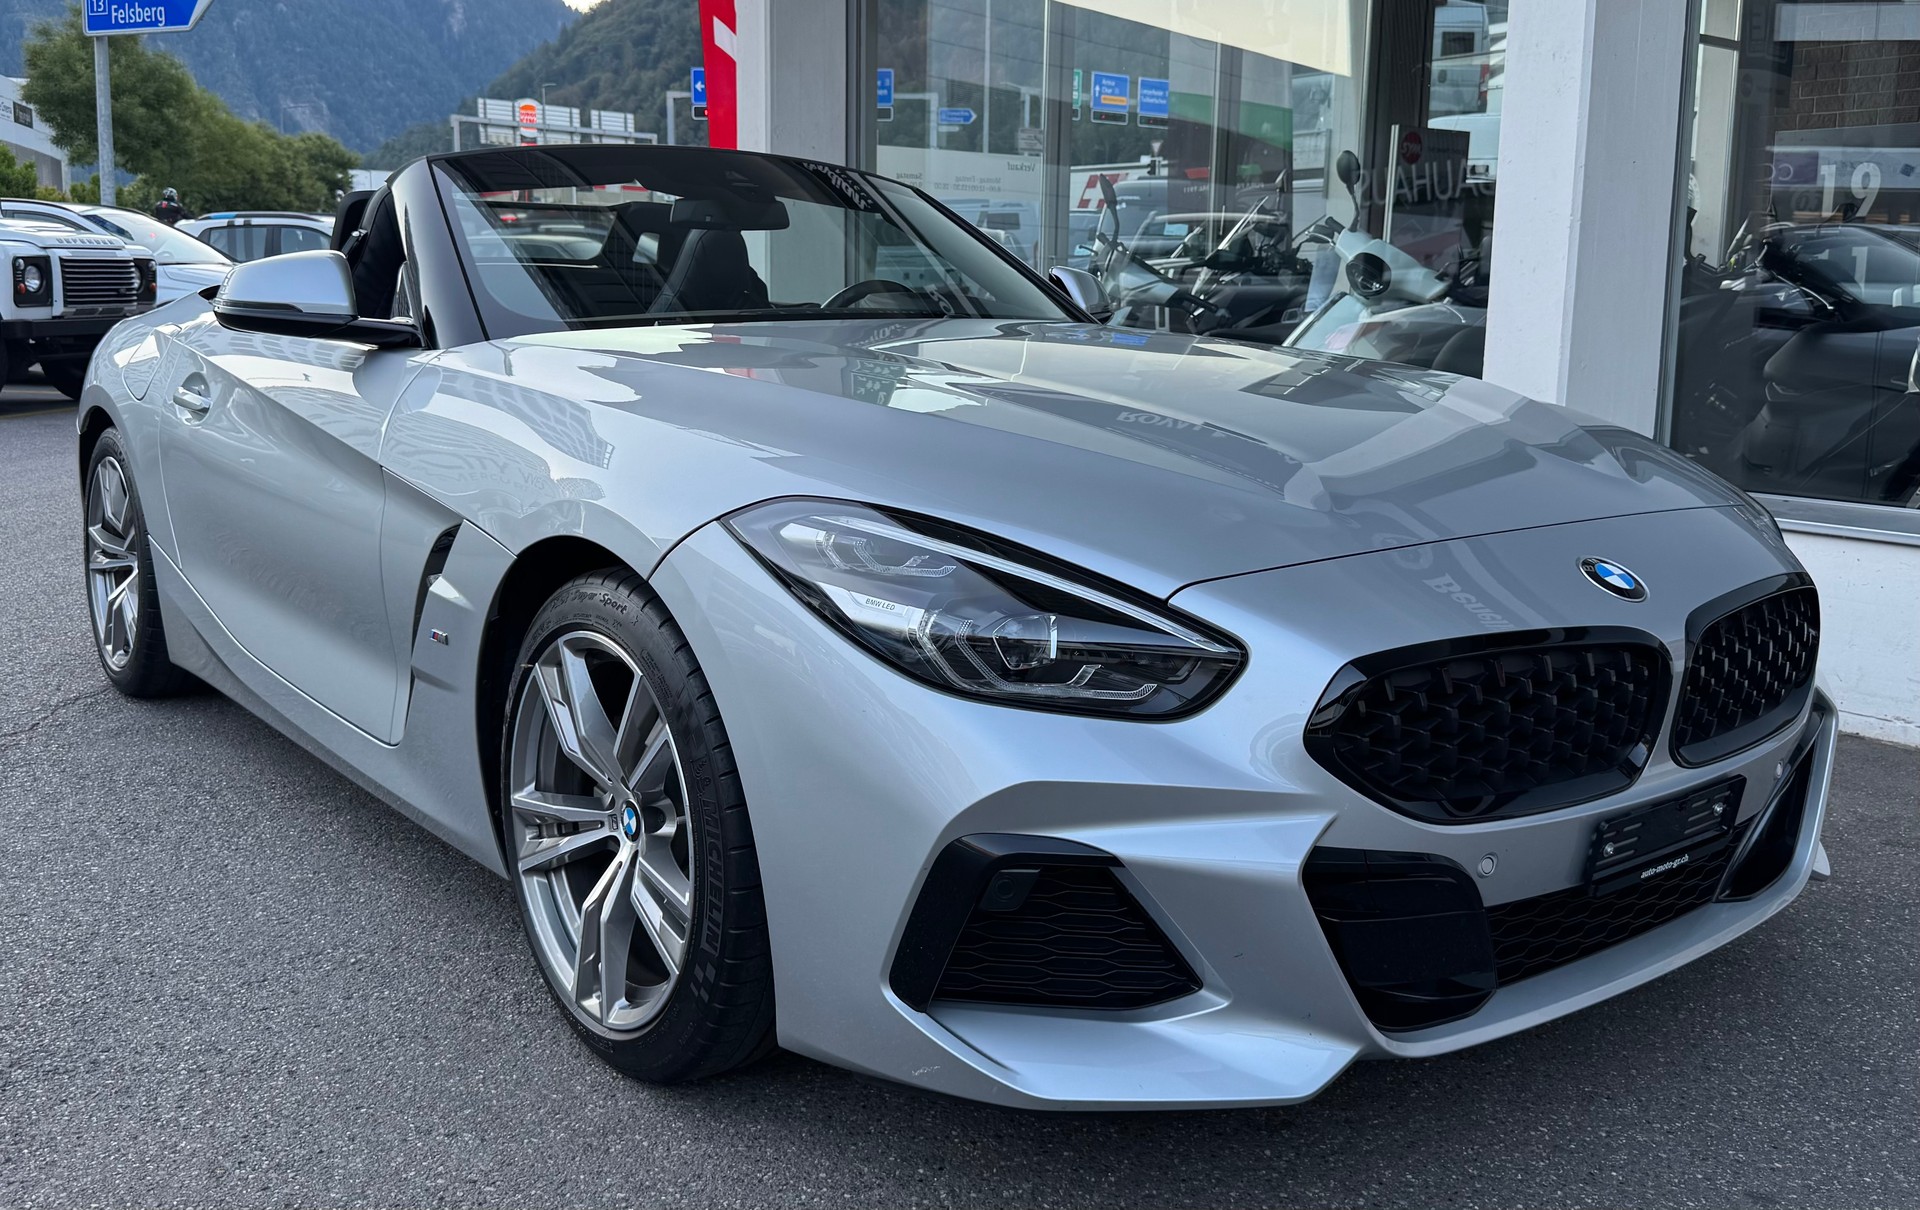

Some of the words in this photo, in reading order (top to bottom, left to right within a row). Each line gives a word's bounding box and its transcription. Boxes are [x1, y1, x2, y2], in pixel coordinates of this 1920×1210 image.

[93, 0, 104, 12] 13
[111, 2, 166, 27] Felsberg
[1820, 161, 1882, 218] 19
[599, 592, 629, 615] Sport
[865, 597, 882, 608] BMW
[882, 602, 896, 611] LED
[700, 798, 725, 956] MICHELIN
[1640, 853, 1690, 879] auto-moto-gr.ch
